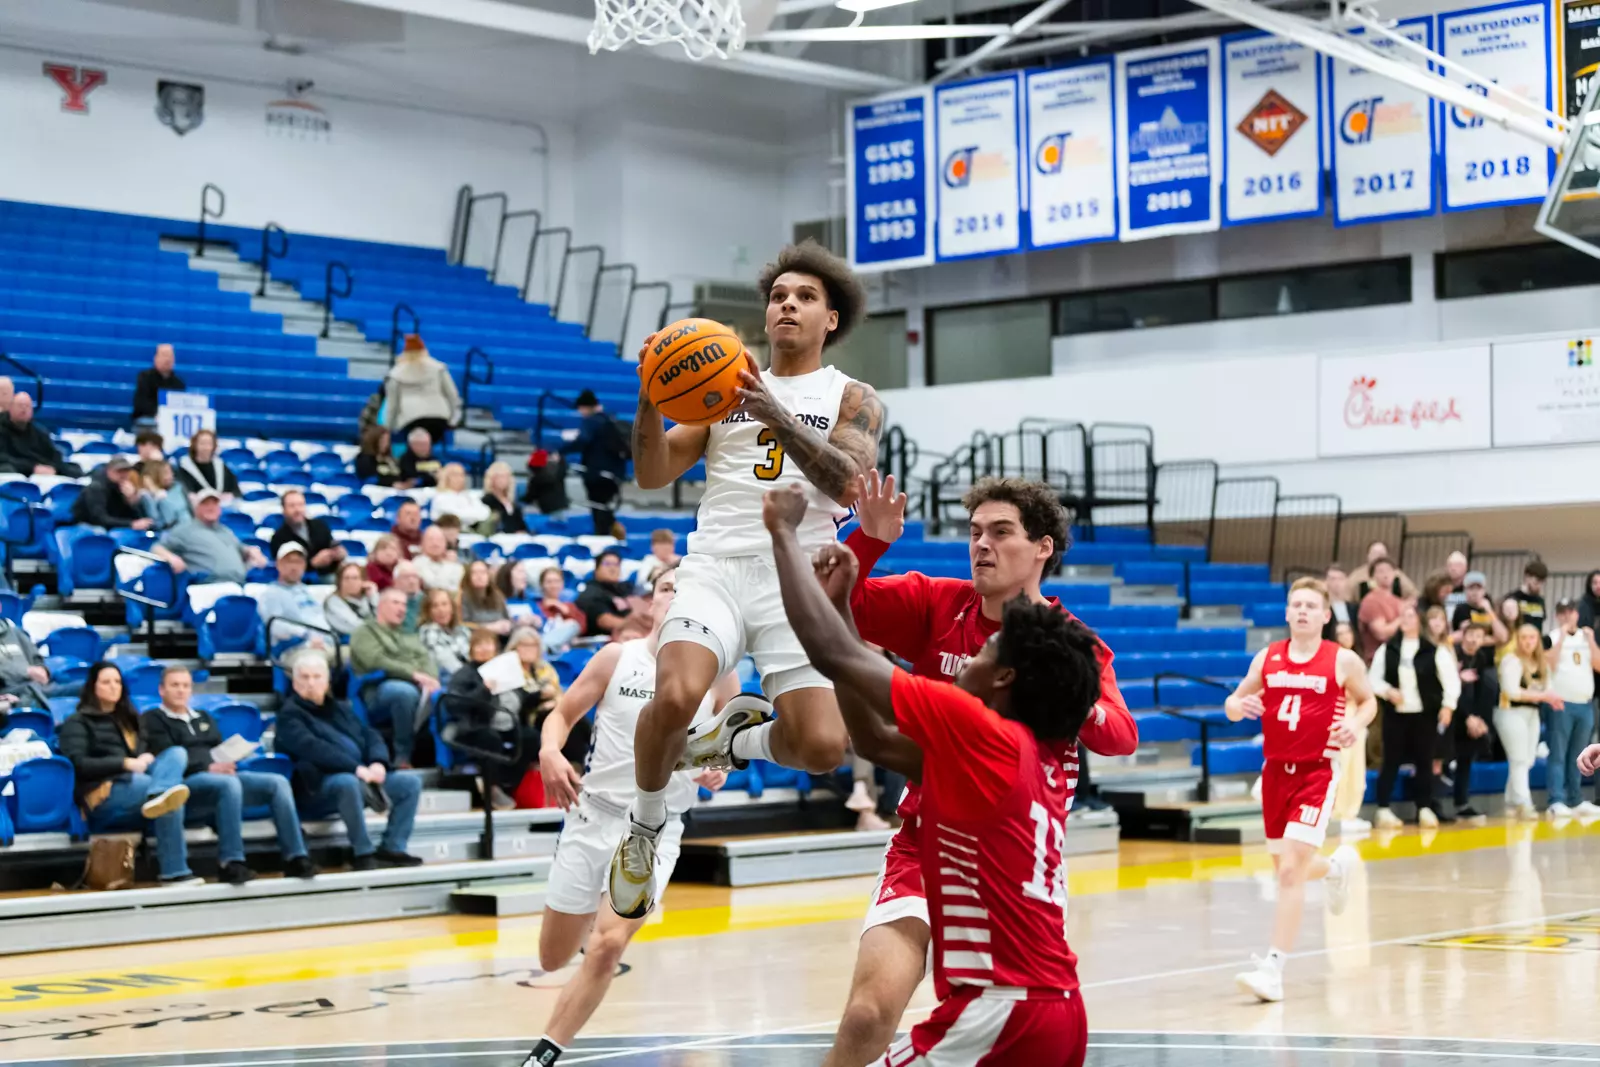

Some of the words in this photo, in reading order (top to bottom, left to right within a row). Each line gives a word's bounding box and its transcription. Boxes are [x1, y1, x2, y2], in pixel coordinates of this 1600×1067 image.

[1252, 114, 1294, 134] NIT
[1465, 156, 1530, 181] 2018
[1243, 171, 1302, 197] 2016
[1353, 170, 1415, 196] 2017
[1047, 198, 1100, 223] 2015
[1146, 189, 1192, 212] 2016
[653, 323, 698, 356] NCAA
[658, 342, 727, 386] Wilson
[172, 414, 203, 438] 107
[753, 427, 785, 481] 3
[1277, 694, 1302, 732] 4
